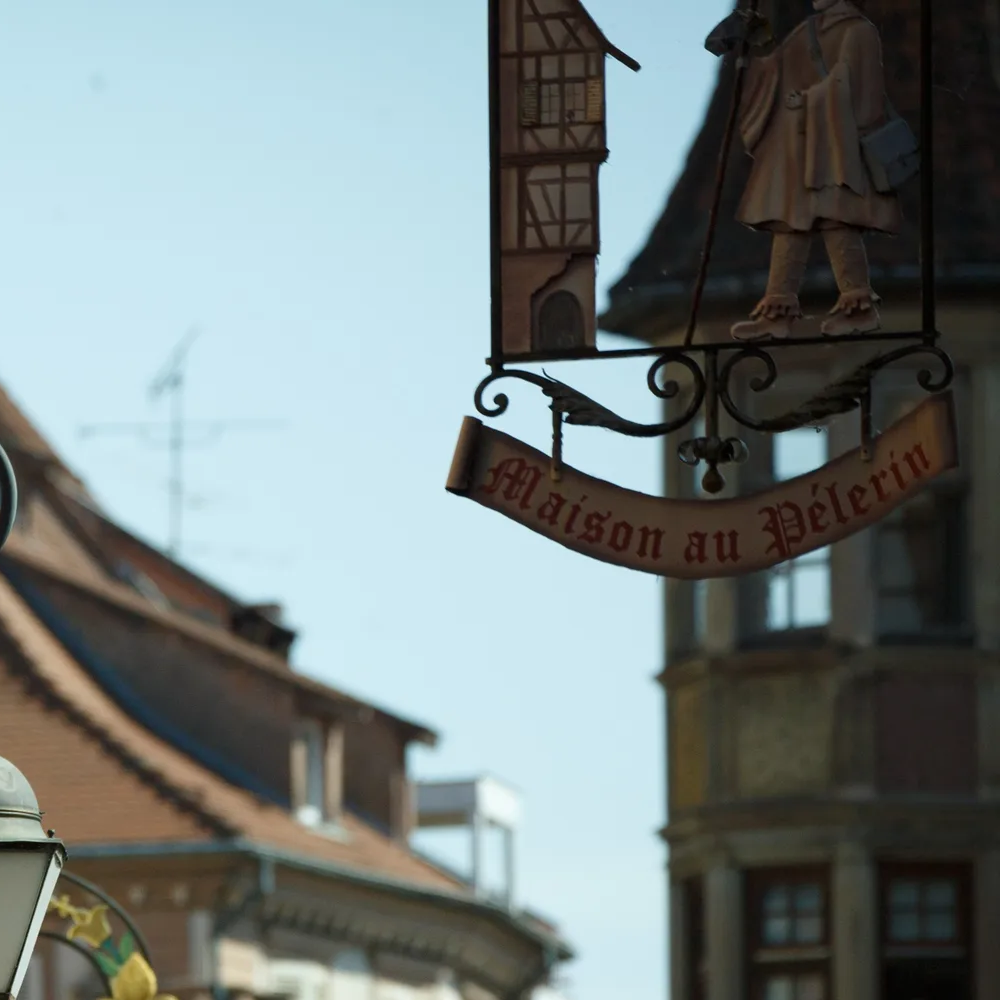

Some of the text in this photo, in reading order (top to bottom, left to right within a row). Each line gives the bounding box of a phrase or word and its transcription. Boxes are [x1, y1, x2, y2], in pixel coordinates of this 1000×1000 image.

[482, 440, 932, 565] Maison au Pélerin
